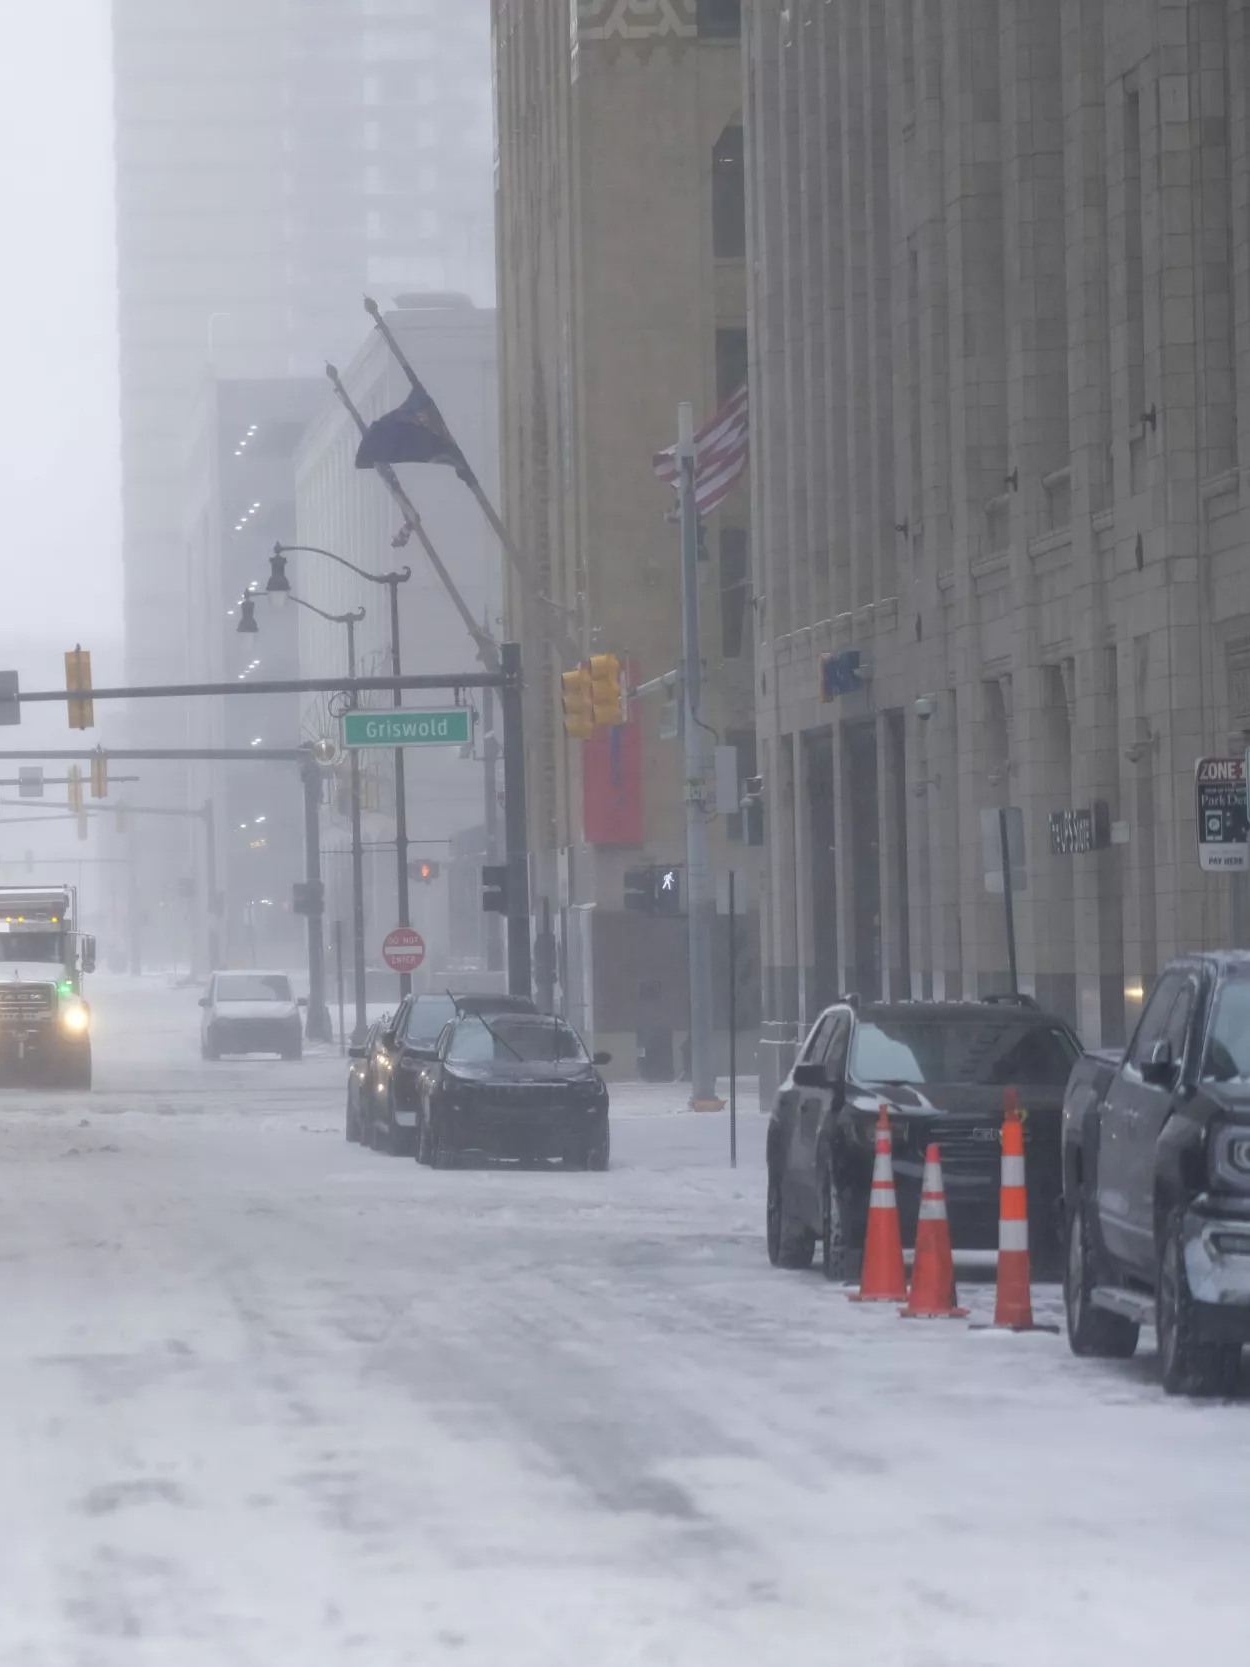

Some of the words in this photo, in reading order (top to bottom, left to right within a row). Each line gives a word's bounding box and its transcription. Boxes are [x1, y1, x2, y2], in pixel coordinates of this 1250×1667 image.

[366, 718, 448, 738] Griswold
[1200, 762, 1237, 780] ZONE
[1201, 794, 1225, 806] Park
[1208, 856, 1222, 865] PAY
[1224, 856, 1243, 865] HERE
[387, 936, 399, 945] DO
[403, 936, 419, 944] NOT
[391, 955, 416, 965] ENTER
